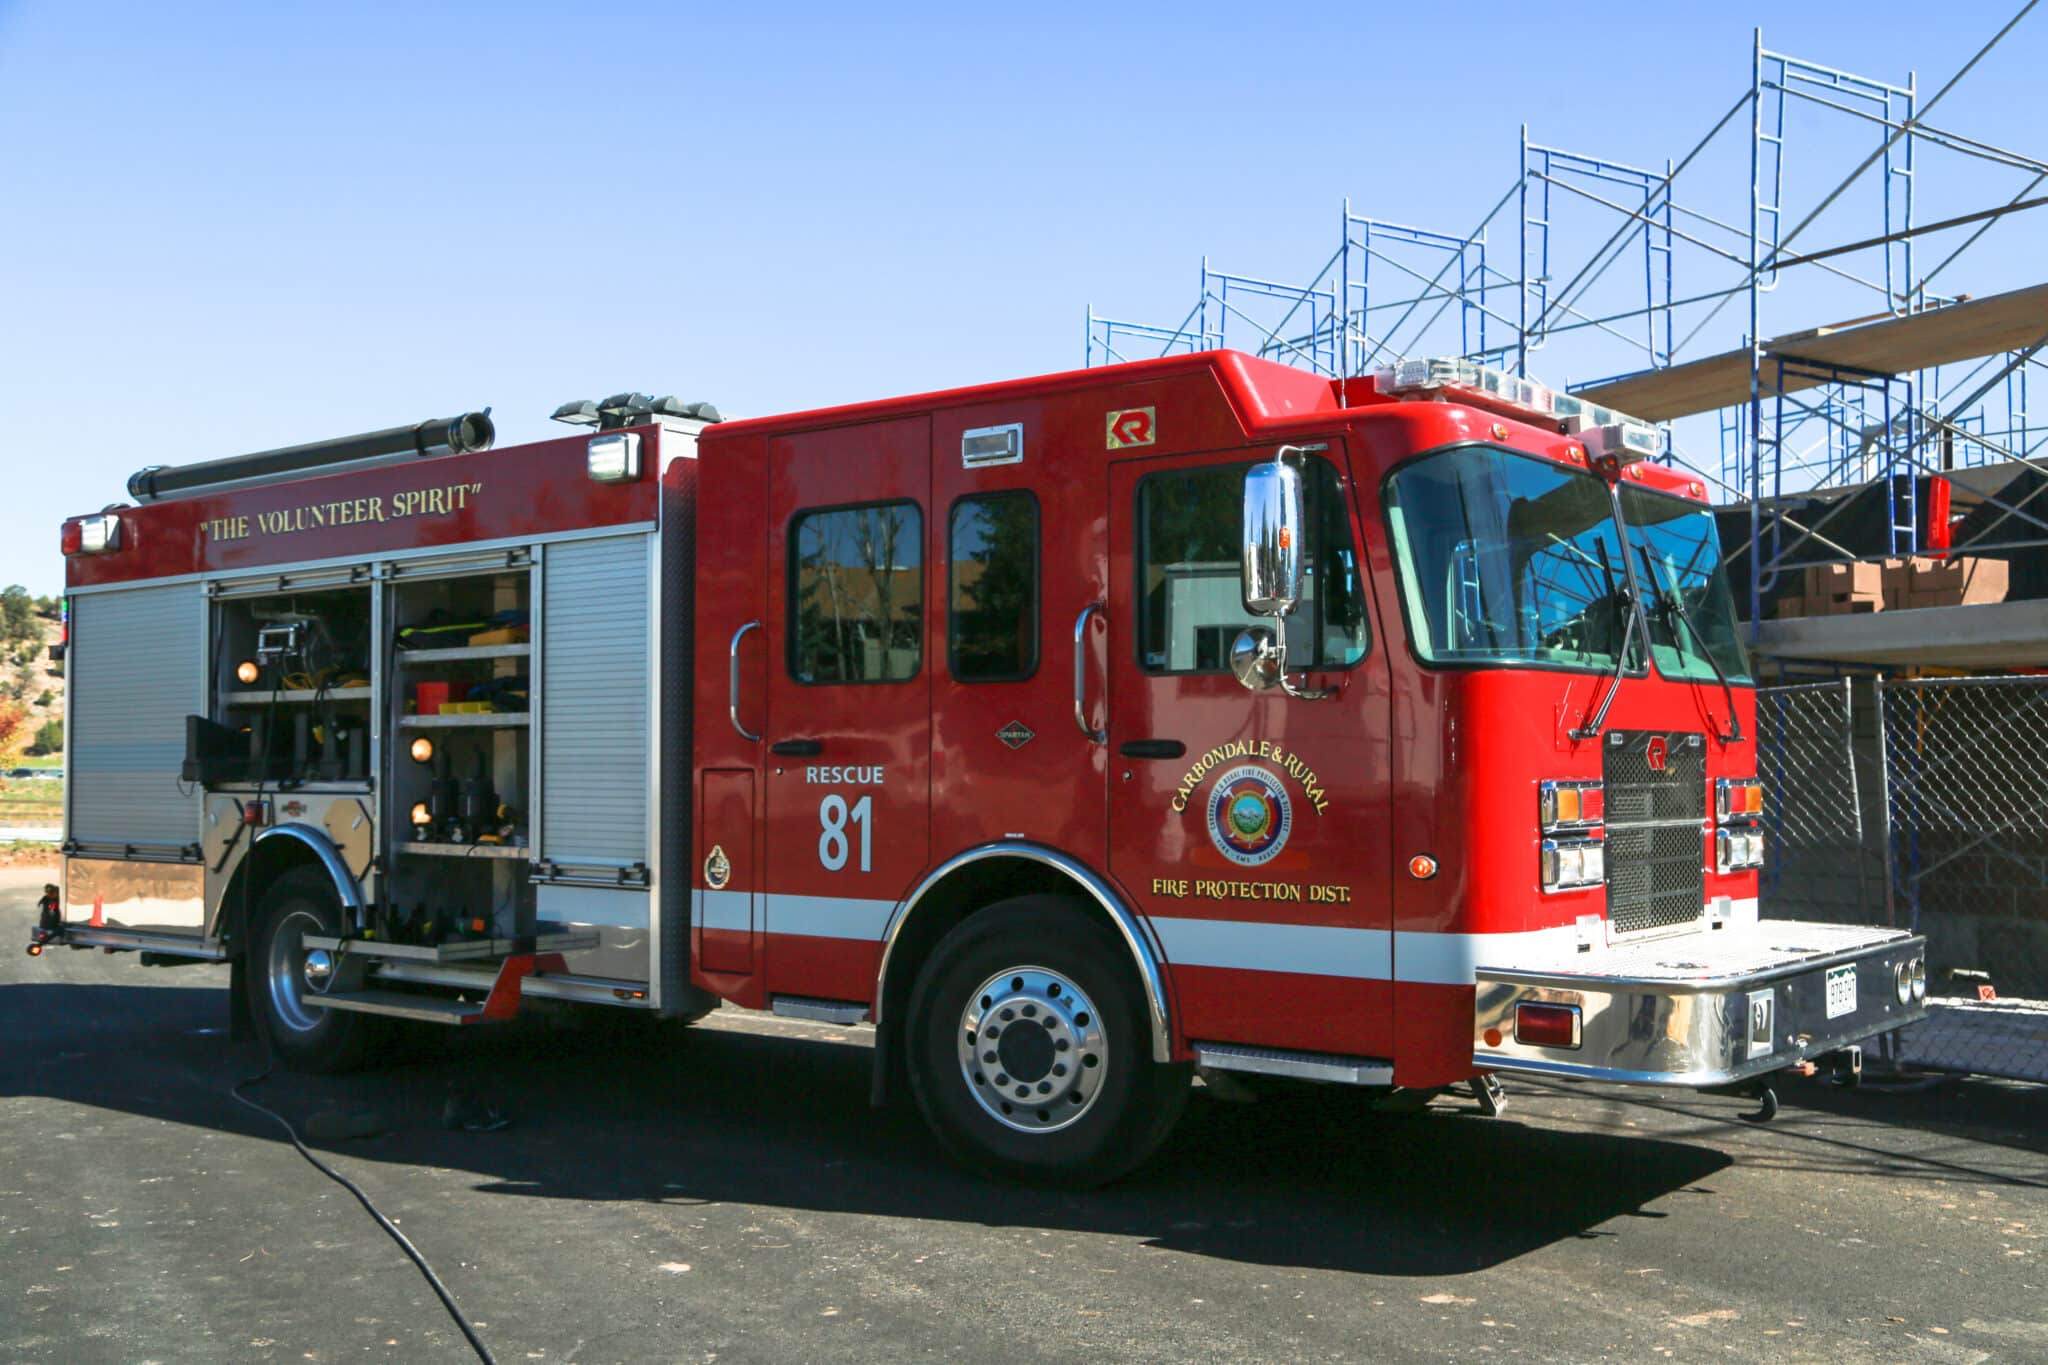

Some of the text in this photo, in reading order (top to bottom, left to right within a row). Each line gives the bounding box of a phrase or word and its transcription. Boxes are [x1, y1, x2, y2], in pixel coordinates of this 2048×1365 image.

[200, 482, 482, 541] "THE VOLUNTEER SPIRIT"
[806, 765, 884, 785] RESCUE
[818, 793, 873, 873] 81
[1152, 878, 1351, 903] FIRE PROTECTION DIST.
